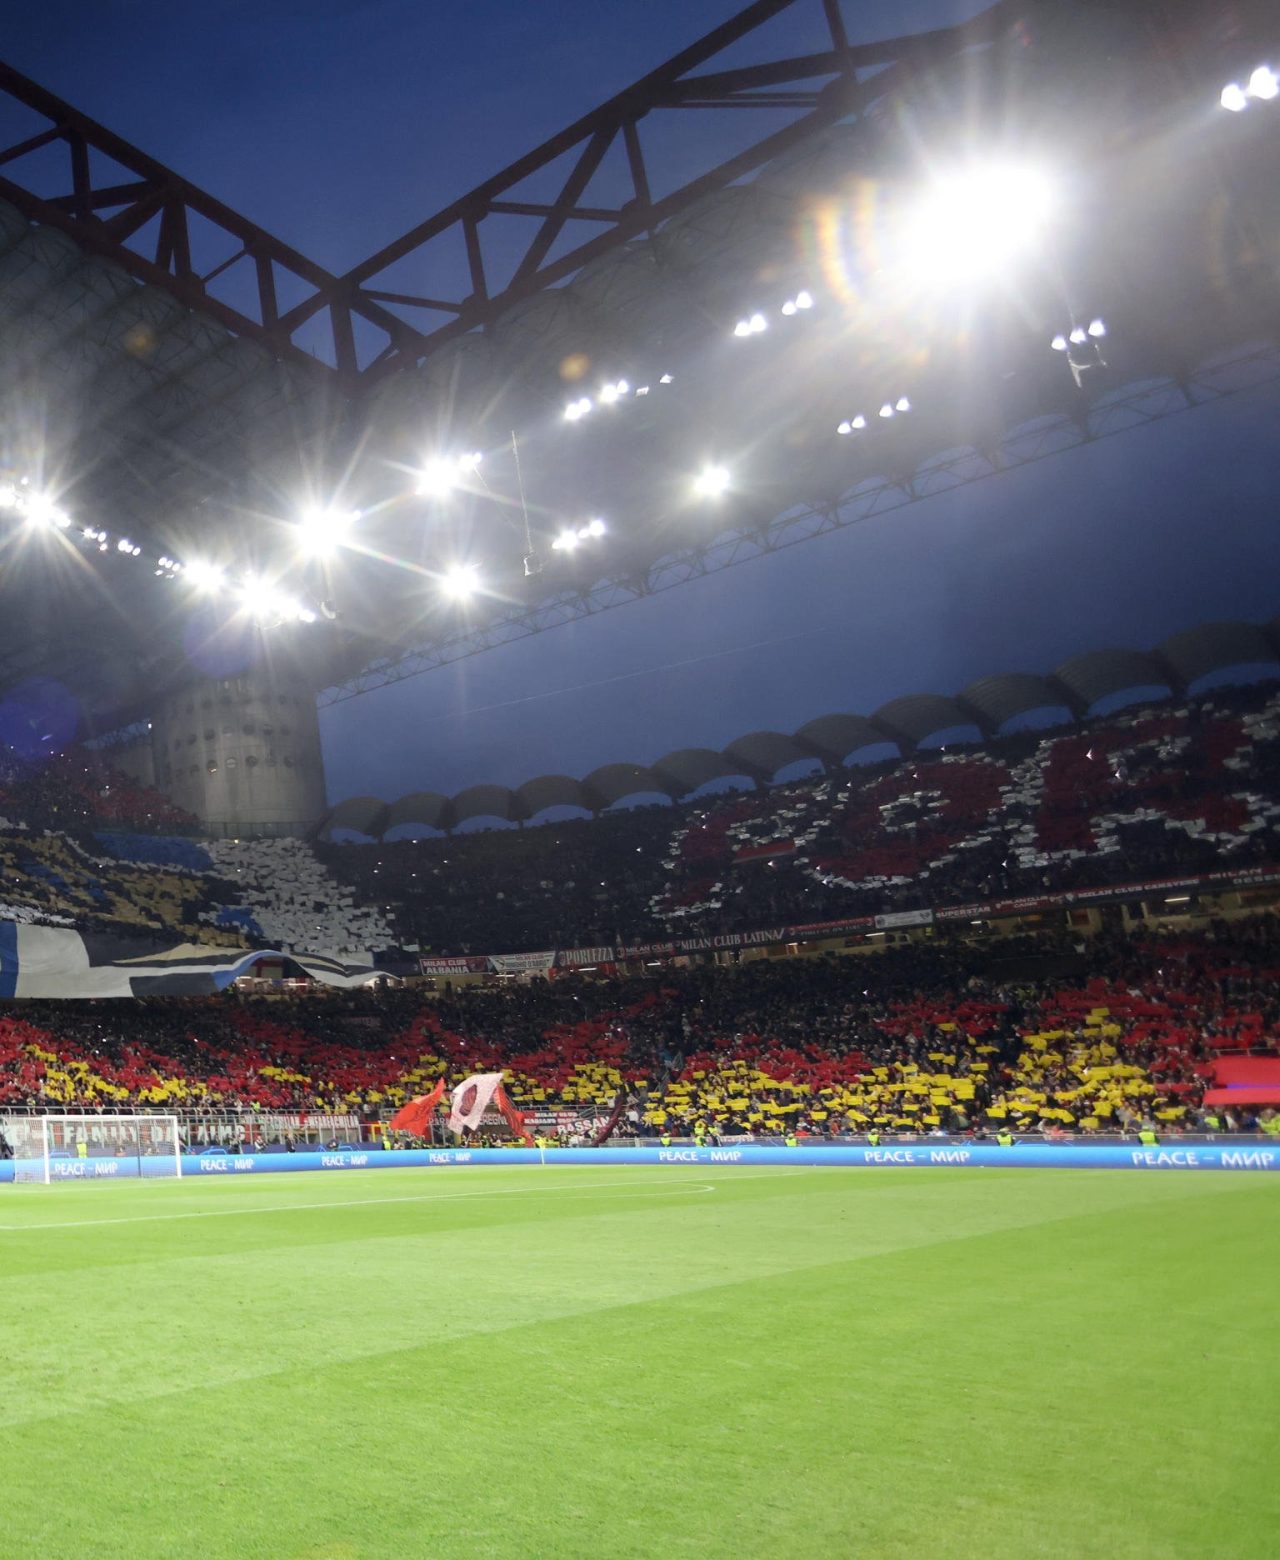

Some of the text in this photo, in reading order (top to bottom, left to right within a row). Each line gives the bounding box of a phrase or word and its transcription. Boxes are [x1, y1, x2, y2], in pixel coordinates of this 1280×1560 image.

[1114, 886, 1143, 894] CLUB
[681, 939, 711, 950] MILAN
[714, 934, 741, 947] CLUB
[426, 966, 470, 974] ALBANIA
[151, 1125, 187, 1141] DAY
[321, 1156, 345, 1166] PEACE
[429, 1153, 450, 1162] PEACE
[659, 1151, 698, 1161] PEACE
[711, 1151, 741, 1161] МИР
[864, 1151, 914, 1162] PEACE
[930, 1151, 970, 1162] МИР
[1131, 1152, 1199, 1165] PEACE
[1221, 1152, 1274, 1166] МИР
[200, 1159, 227, 1170] PEACE
[235, 1158, 254, 1169] МИР
